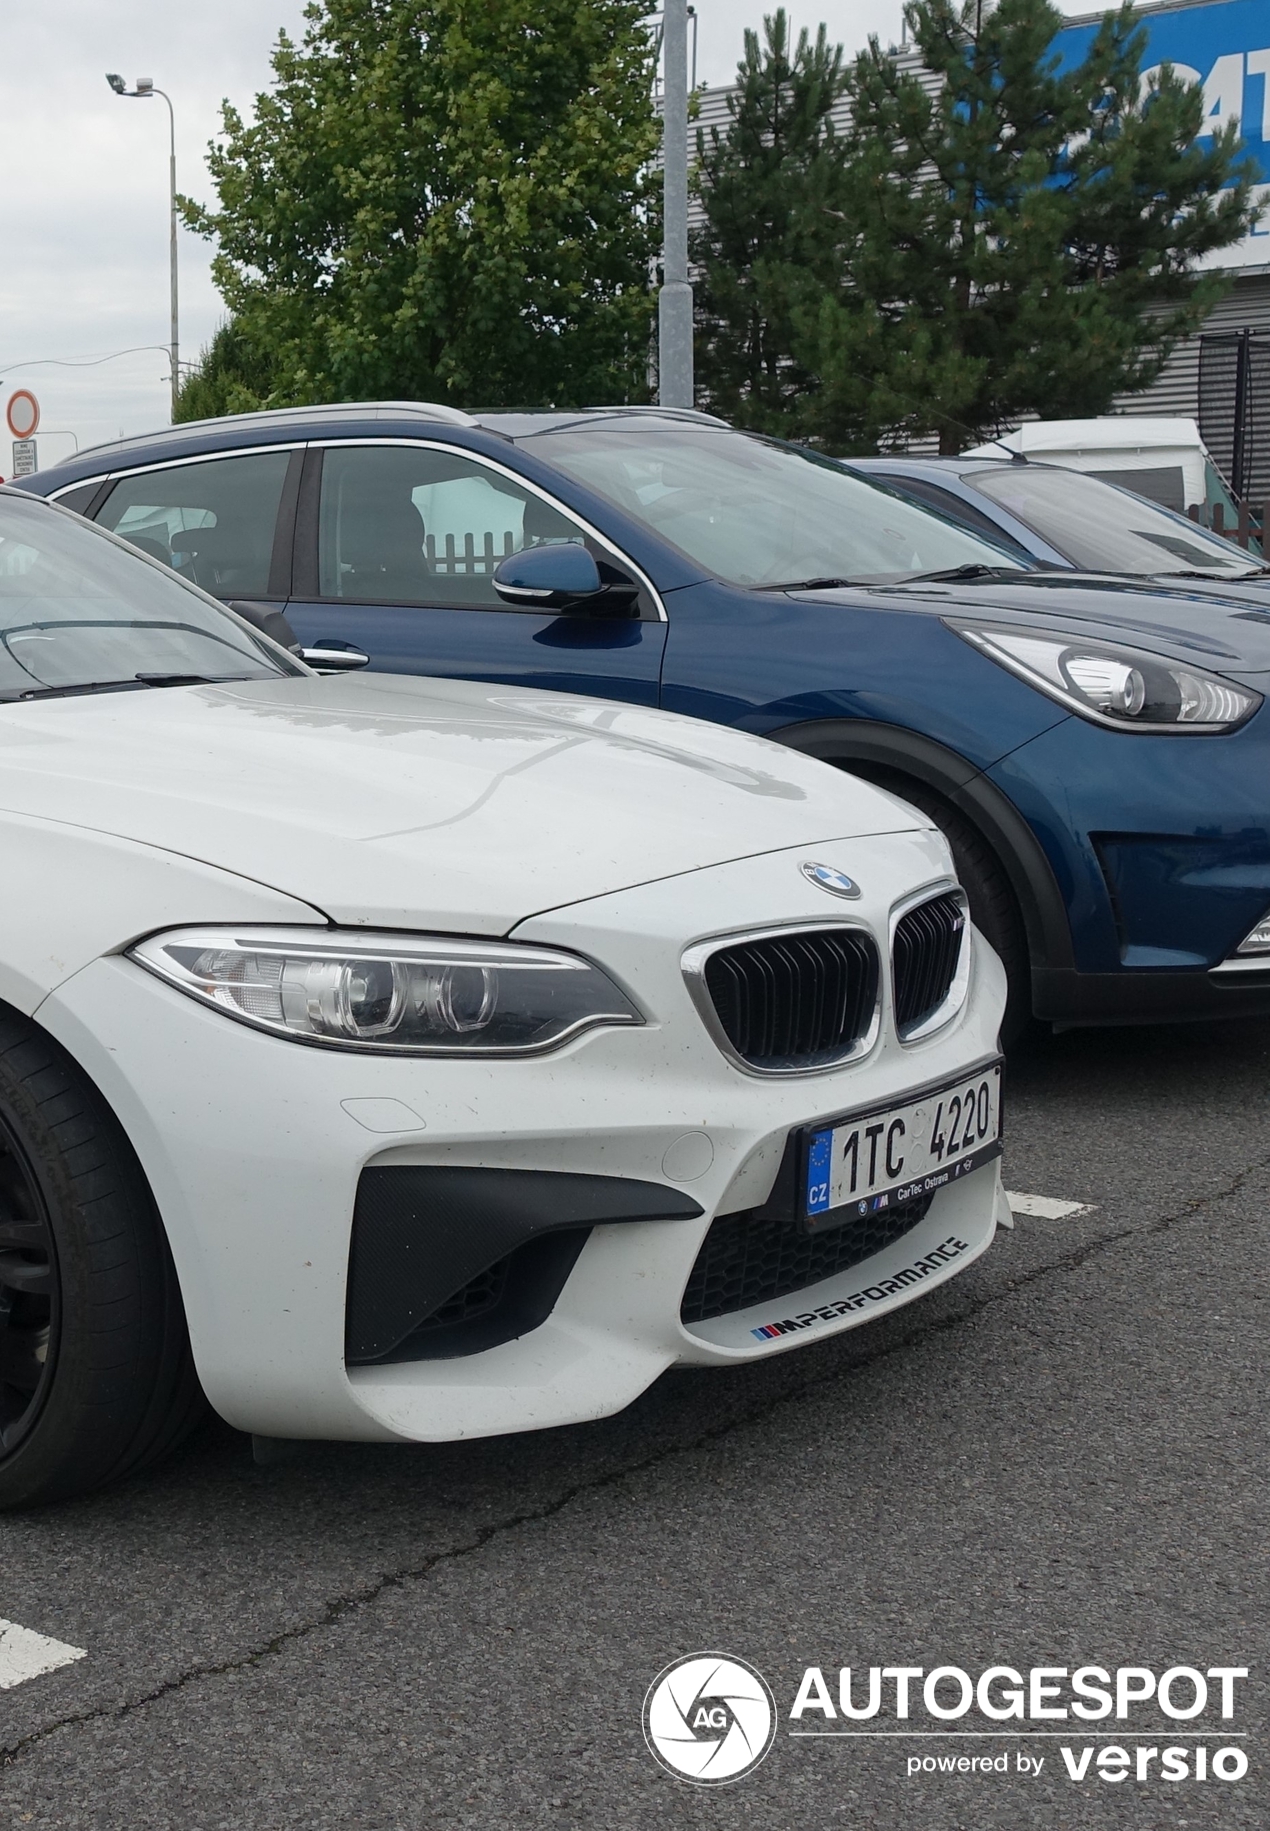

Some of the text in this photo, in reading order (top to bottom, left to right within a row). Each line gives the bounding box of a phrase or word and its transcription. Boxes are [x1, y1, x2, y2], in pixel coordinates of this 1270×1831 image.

[842, 1081, 989, 1193] 1TC 4220
[809, 1182, 827, 1205] CZ
[897, 1185, 923, 1200] CarTec
[924, 1172, 949, 1190] Ostrava
